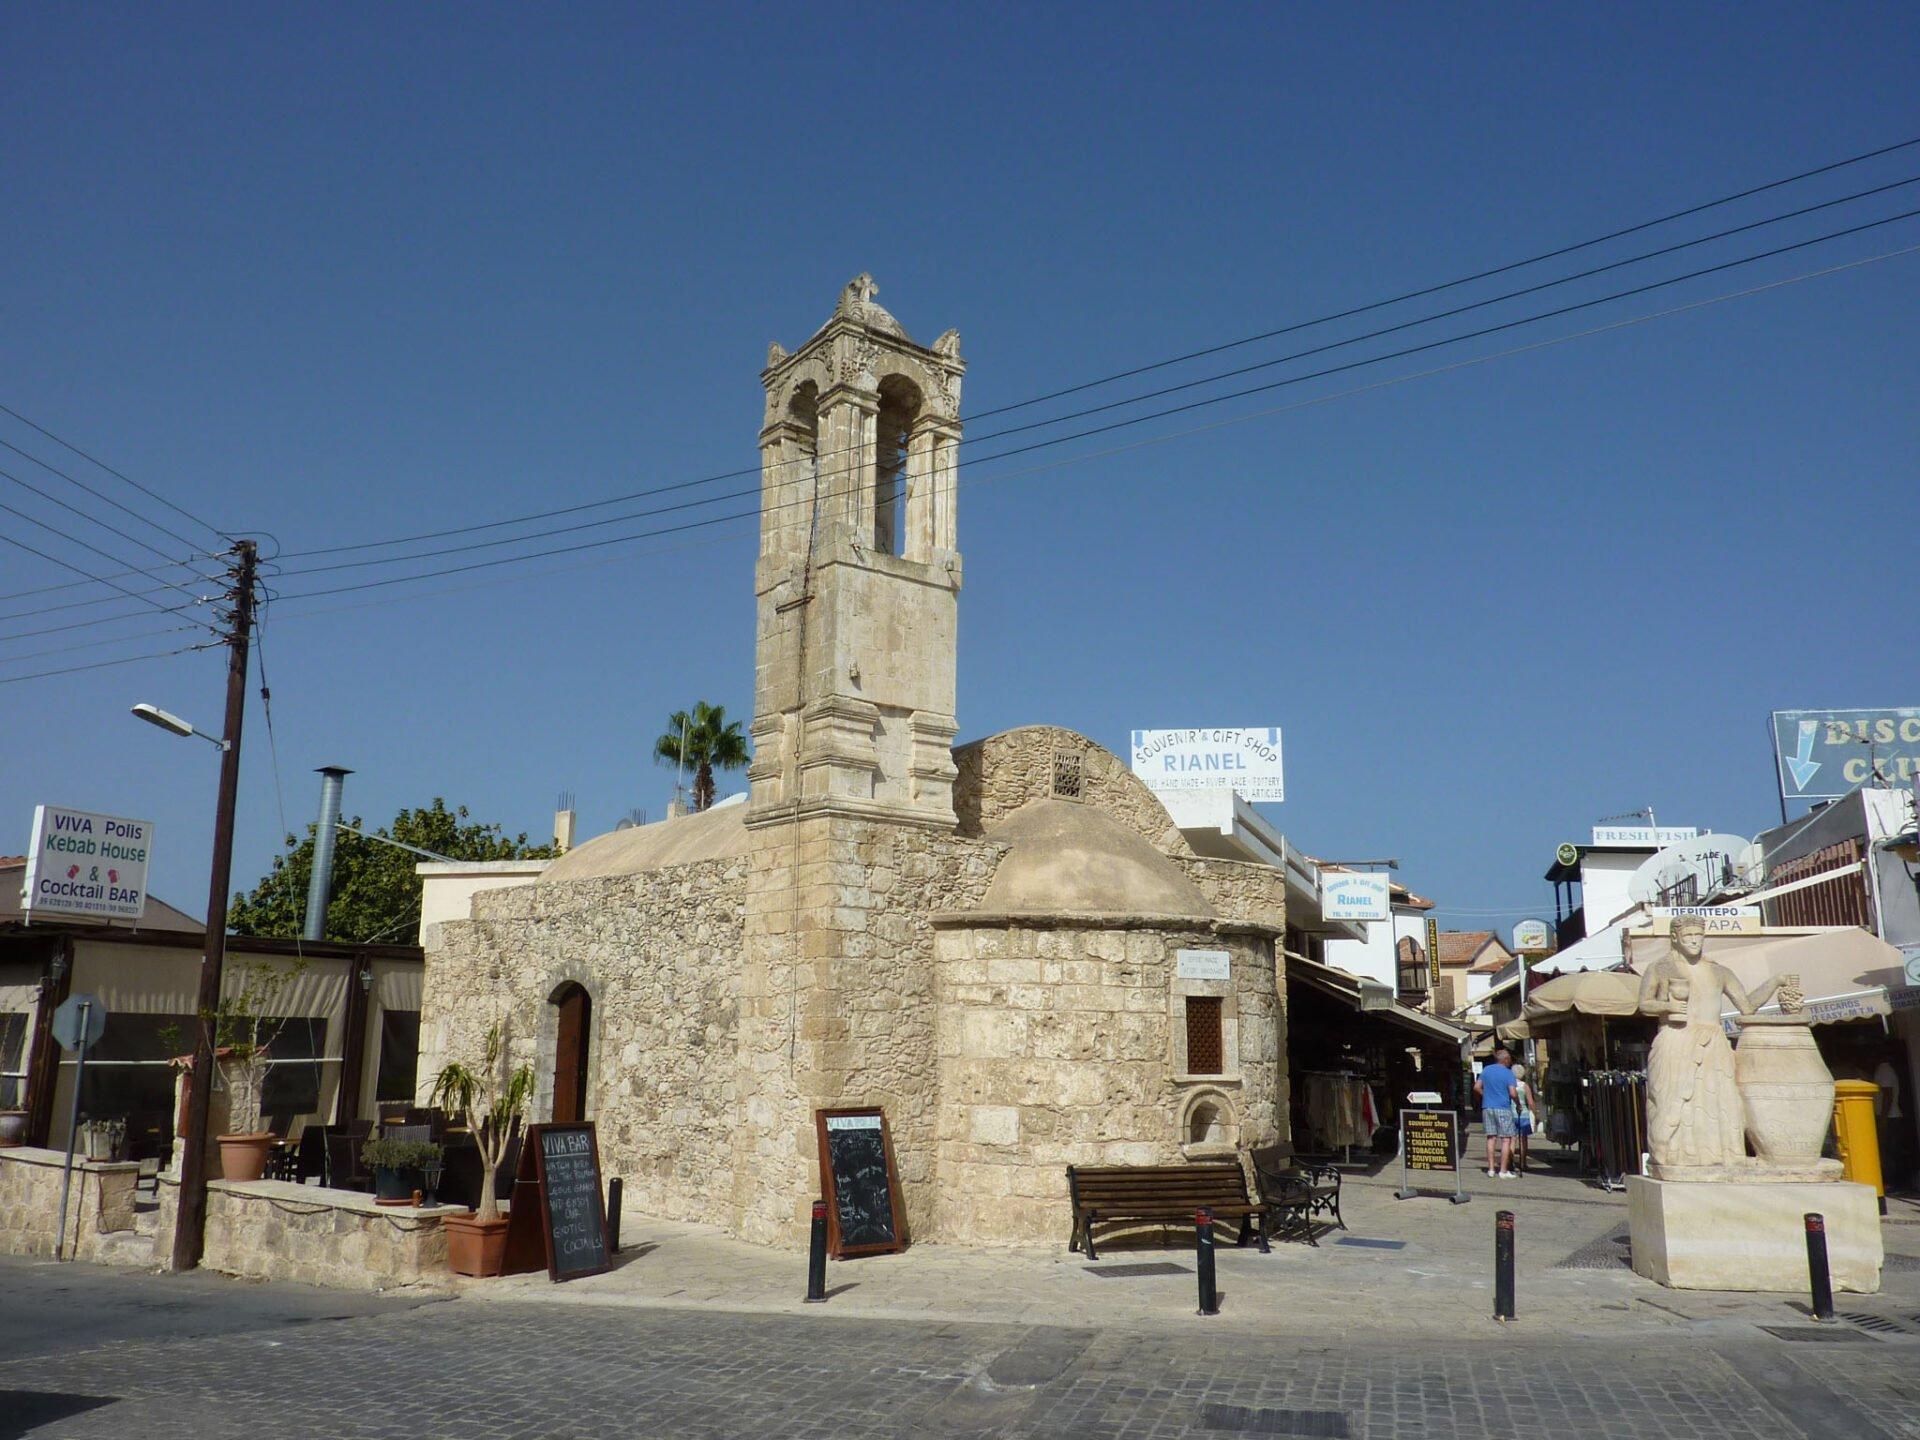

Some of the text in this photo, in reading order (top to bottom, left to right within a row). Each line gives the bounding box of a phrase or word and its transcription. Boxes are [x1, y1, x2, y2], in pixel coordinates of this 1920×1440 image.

[1136, 731, 1277, 764] SOUVENIR & GIFT SHOP
[1164, 753, 1246, 772] RIANEL
[55, 815, 142, 839] VIVA Polis
[1596, 831, 1694, 840] FRESH FISH
[46, 834, 146, 862] Kebab House
[90, 866, 99, 881] &
[40, 879, 138, 904] Cocktail BAR
[542, 1134, 590, 1154] VIVA BAR
[1411, 1131, 1447, 1140] TELECARDS
[1411, 1139, 1449, 1147] CIGARETTES
[1412, 1147, 1445, 1155] TOBACCOS
